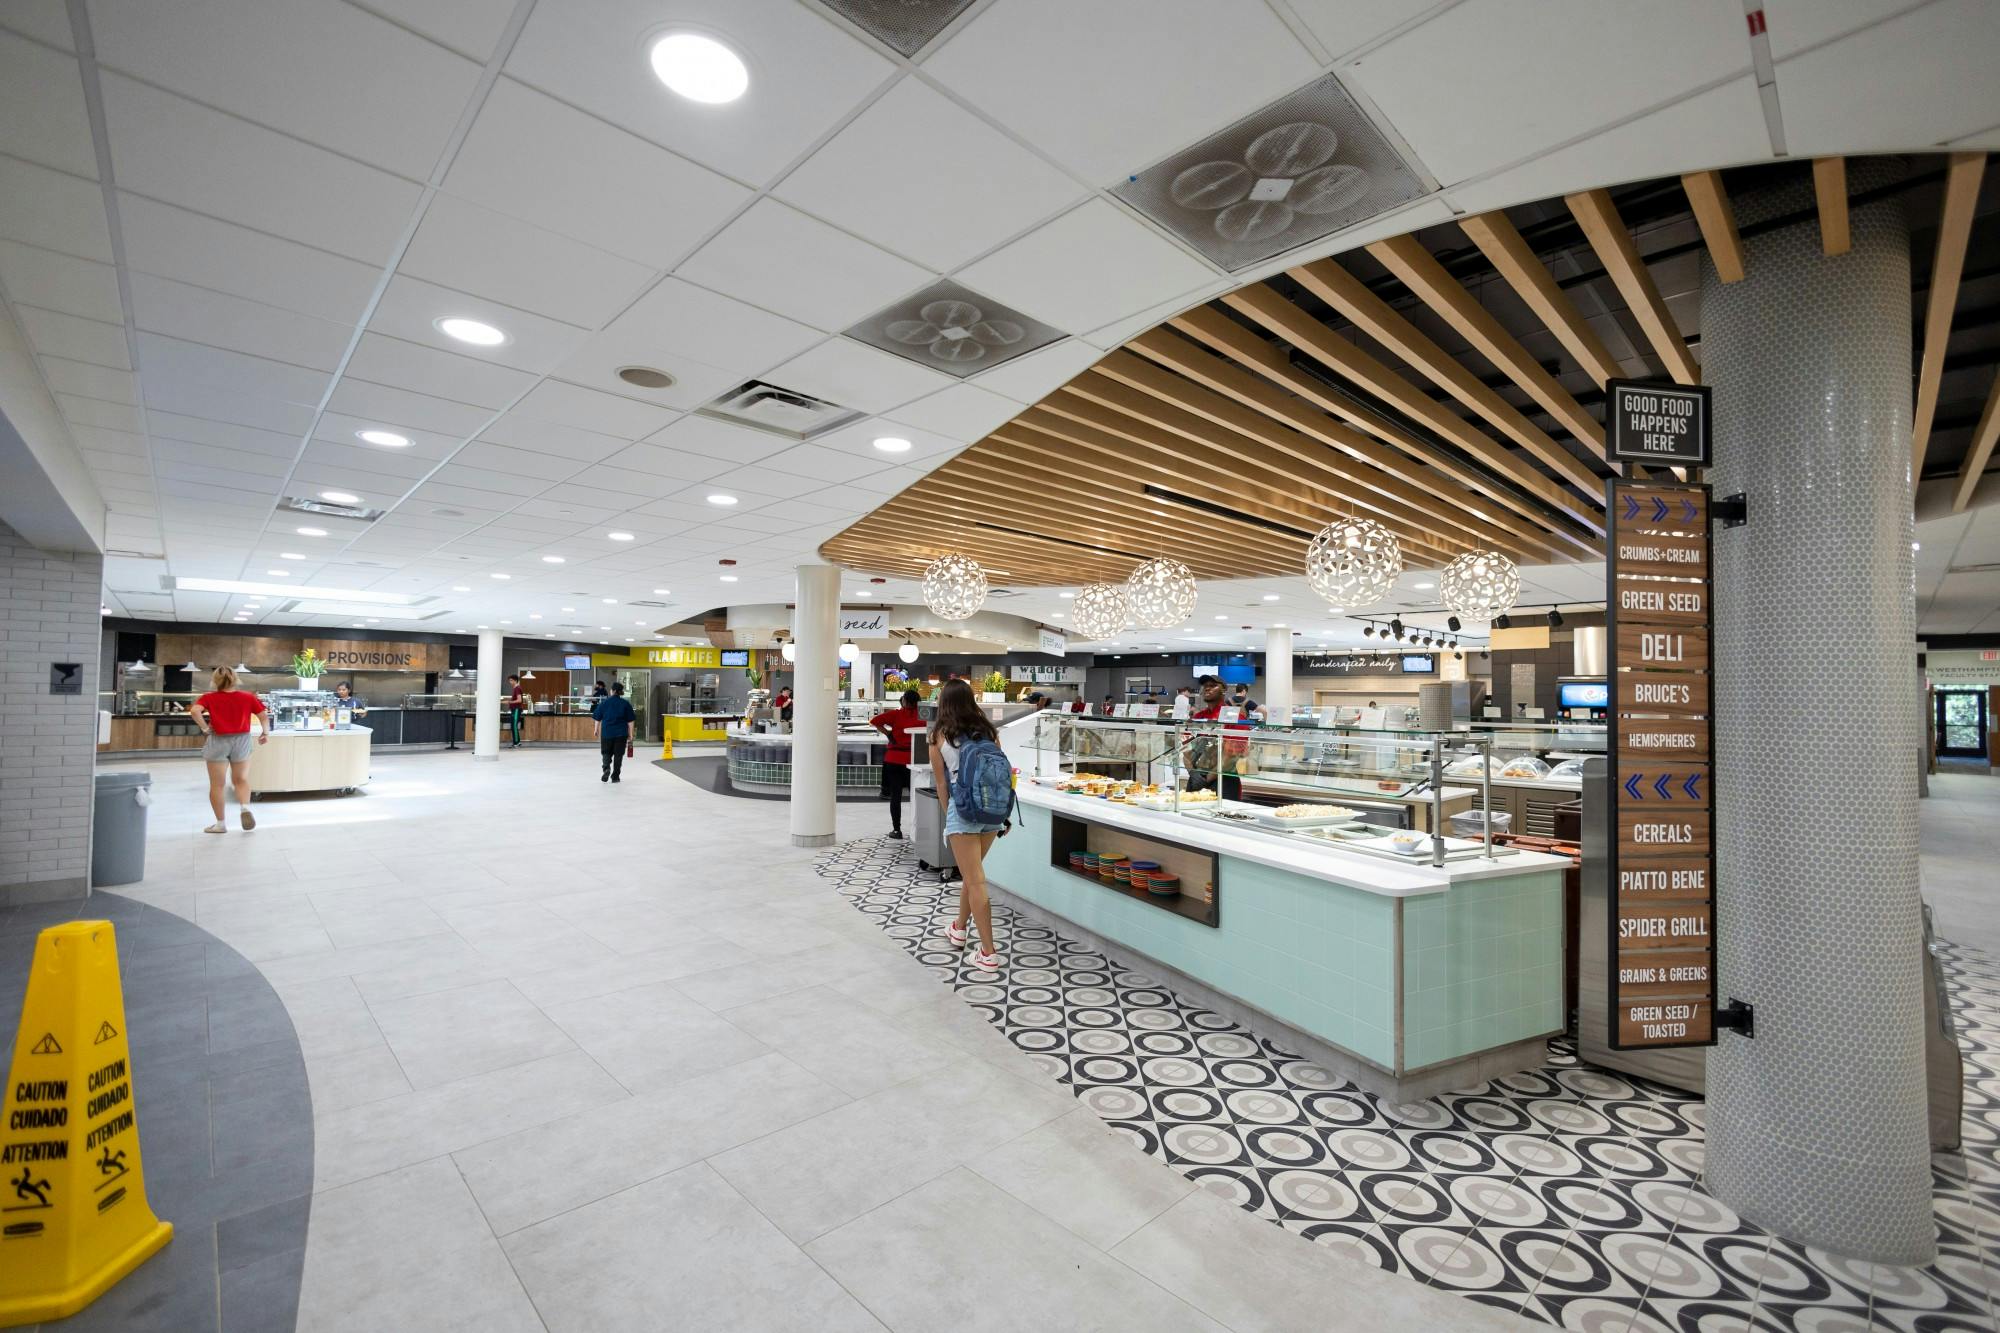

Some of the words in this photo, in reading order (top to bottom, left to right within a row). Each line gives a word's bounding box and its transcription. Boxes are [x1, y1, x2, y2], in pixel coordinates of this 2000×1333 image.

[1625, 394, 1658, 413] GOOD
[1662, 398, 1693, 417] FOOD
[1631, 413, 1687, 434] HAPPENS
[1643, 433, 1675, 452] HERE
[1620, 546, 1700, 563] CRUMBS+CREAM
[1621, 590, 1664, 611] GREEN
[1668, 592, 1701, 612] SEED
[843, 615, 883, 630] seed
[648, 650, 713, 665] PLANTLIFE
[1641, 633, 1683, 662] DELI
[328, 651, 412, 666] PROVISIONS
[1310, 659, 1366, 671] handcrafted
[1369, 658, 1397, 671] daily
[1635, 684, 1690, 704] BRUCE'S
[1629, 734, 1696, 748] HEMISPHERES
[1634, 823, 1692, 843] CEREALS
[1621, 871, 1667, 890] PIATTO
[1671, 870, 1705, 889] BENE
[1619, 918, 1666, 937] SPIDER
[1671, 917, 1707, 936] GRILL
[1620, 968, 1656, 983] GRAINS
[1658, 968, 1667, 982] &
[1669, 966, 1707, 982] GREENS
[1630, 1006, 1662, 1022] GREEN
[1665, 1005, 1689, 1020] SEED
[1692, 1003, 1698, 1020] /
[1643, 1023, 1686, 1039] TOASTED
[88, 1059, 125, 1092] CAUTION
[16, 1081, 68, 1102] CAUTION
[87, 1082, 129, 1119] CUIDADO
[10, 1108, 68, 1130] CUIDADO
[86, 1109, 133, 1152] ATTENTION
[1, 1141, 69, 1164] ATTENTION
